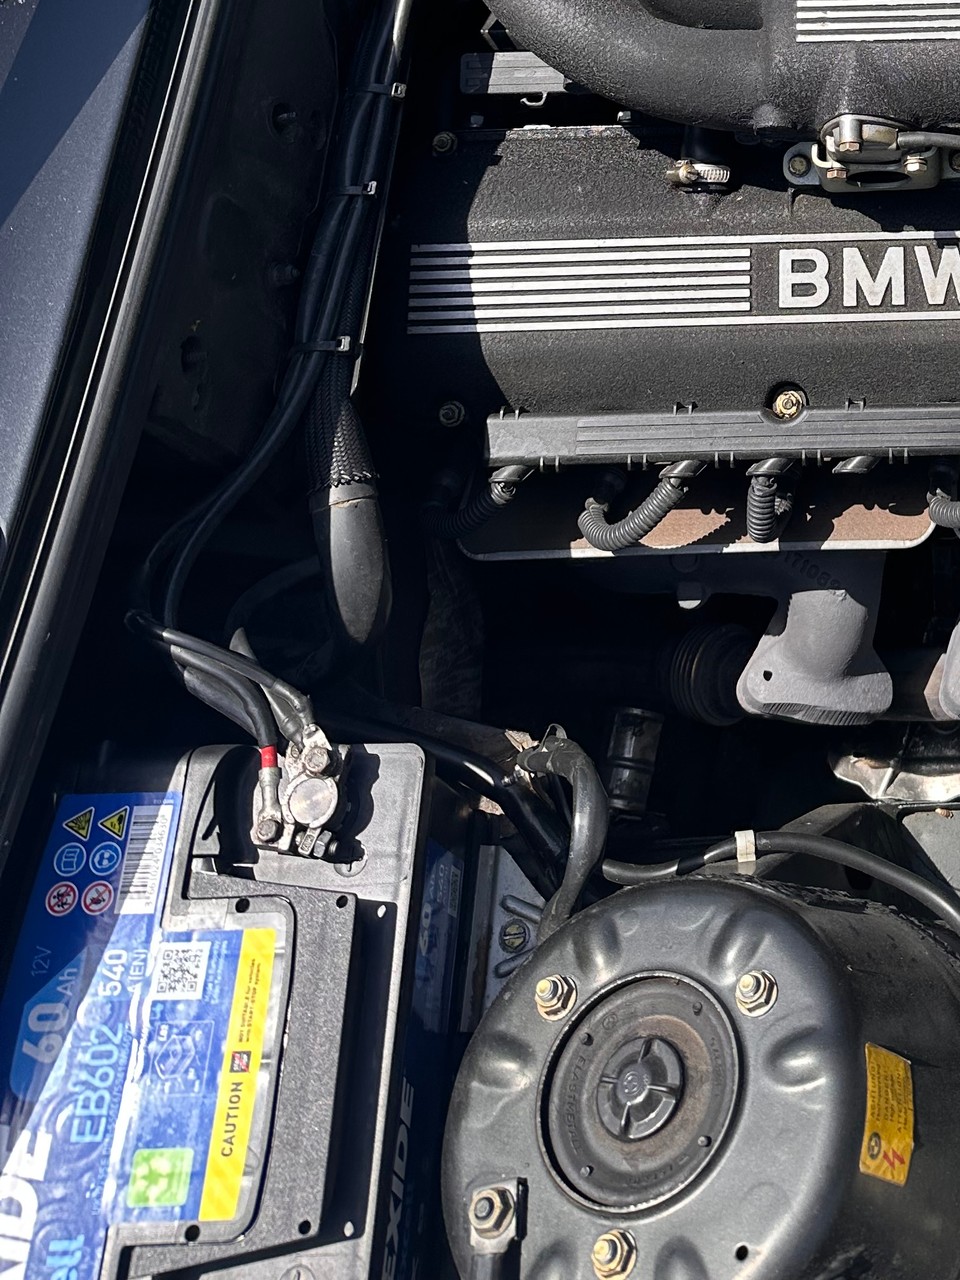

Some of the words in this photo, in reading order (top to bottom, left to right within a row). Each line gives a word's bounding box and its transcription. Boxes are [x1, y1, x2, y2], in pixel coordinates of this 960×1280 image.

[30, 945, 52, 977] 12V
[420, 902, 432, 956] 60
[98, 949, 128, 997] 540
[22, 1002, 69, 1064] 60
[56, 967, 78, 998] Ah
[70, 1021, 124, 1144] EB602
[220, 1081, 242, 1158] CAUTION
[382, 1076, 414, 1280] EXIDE
